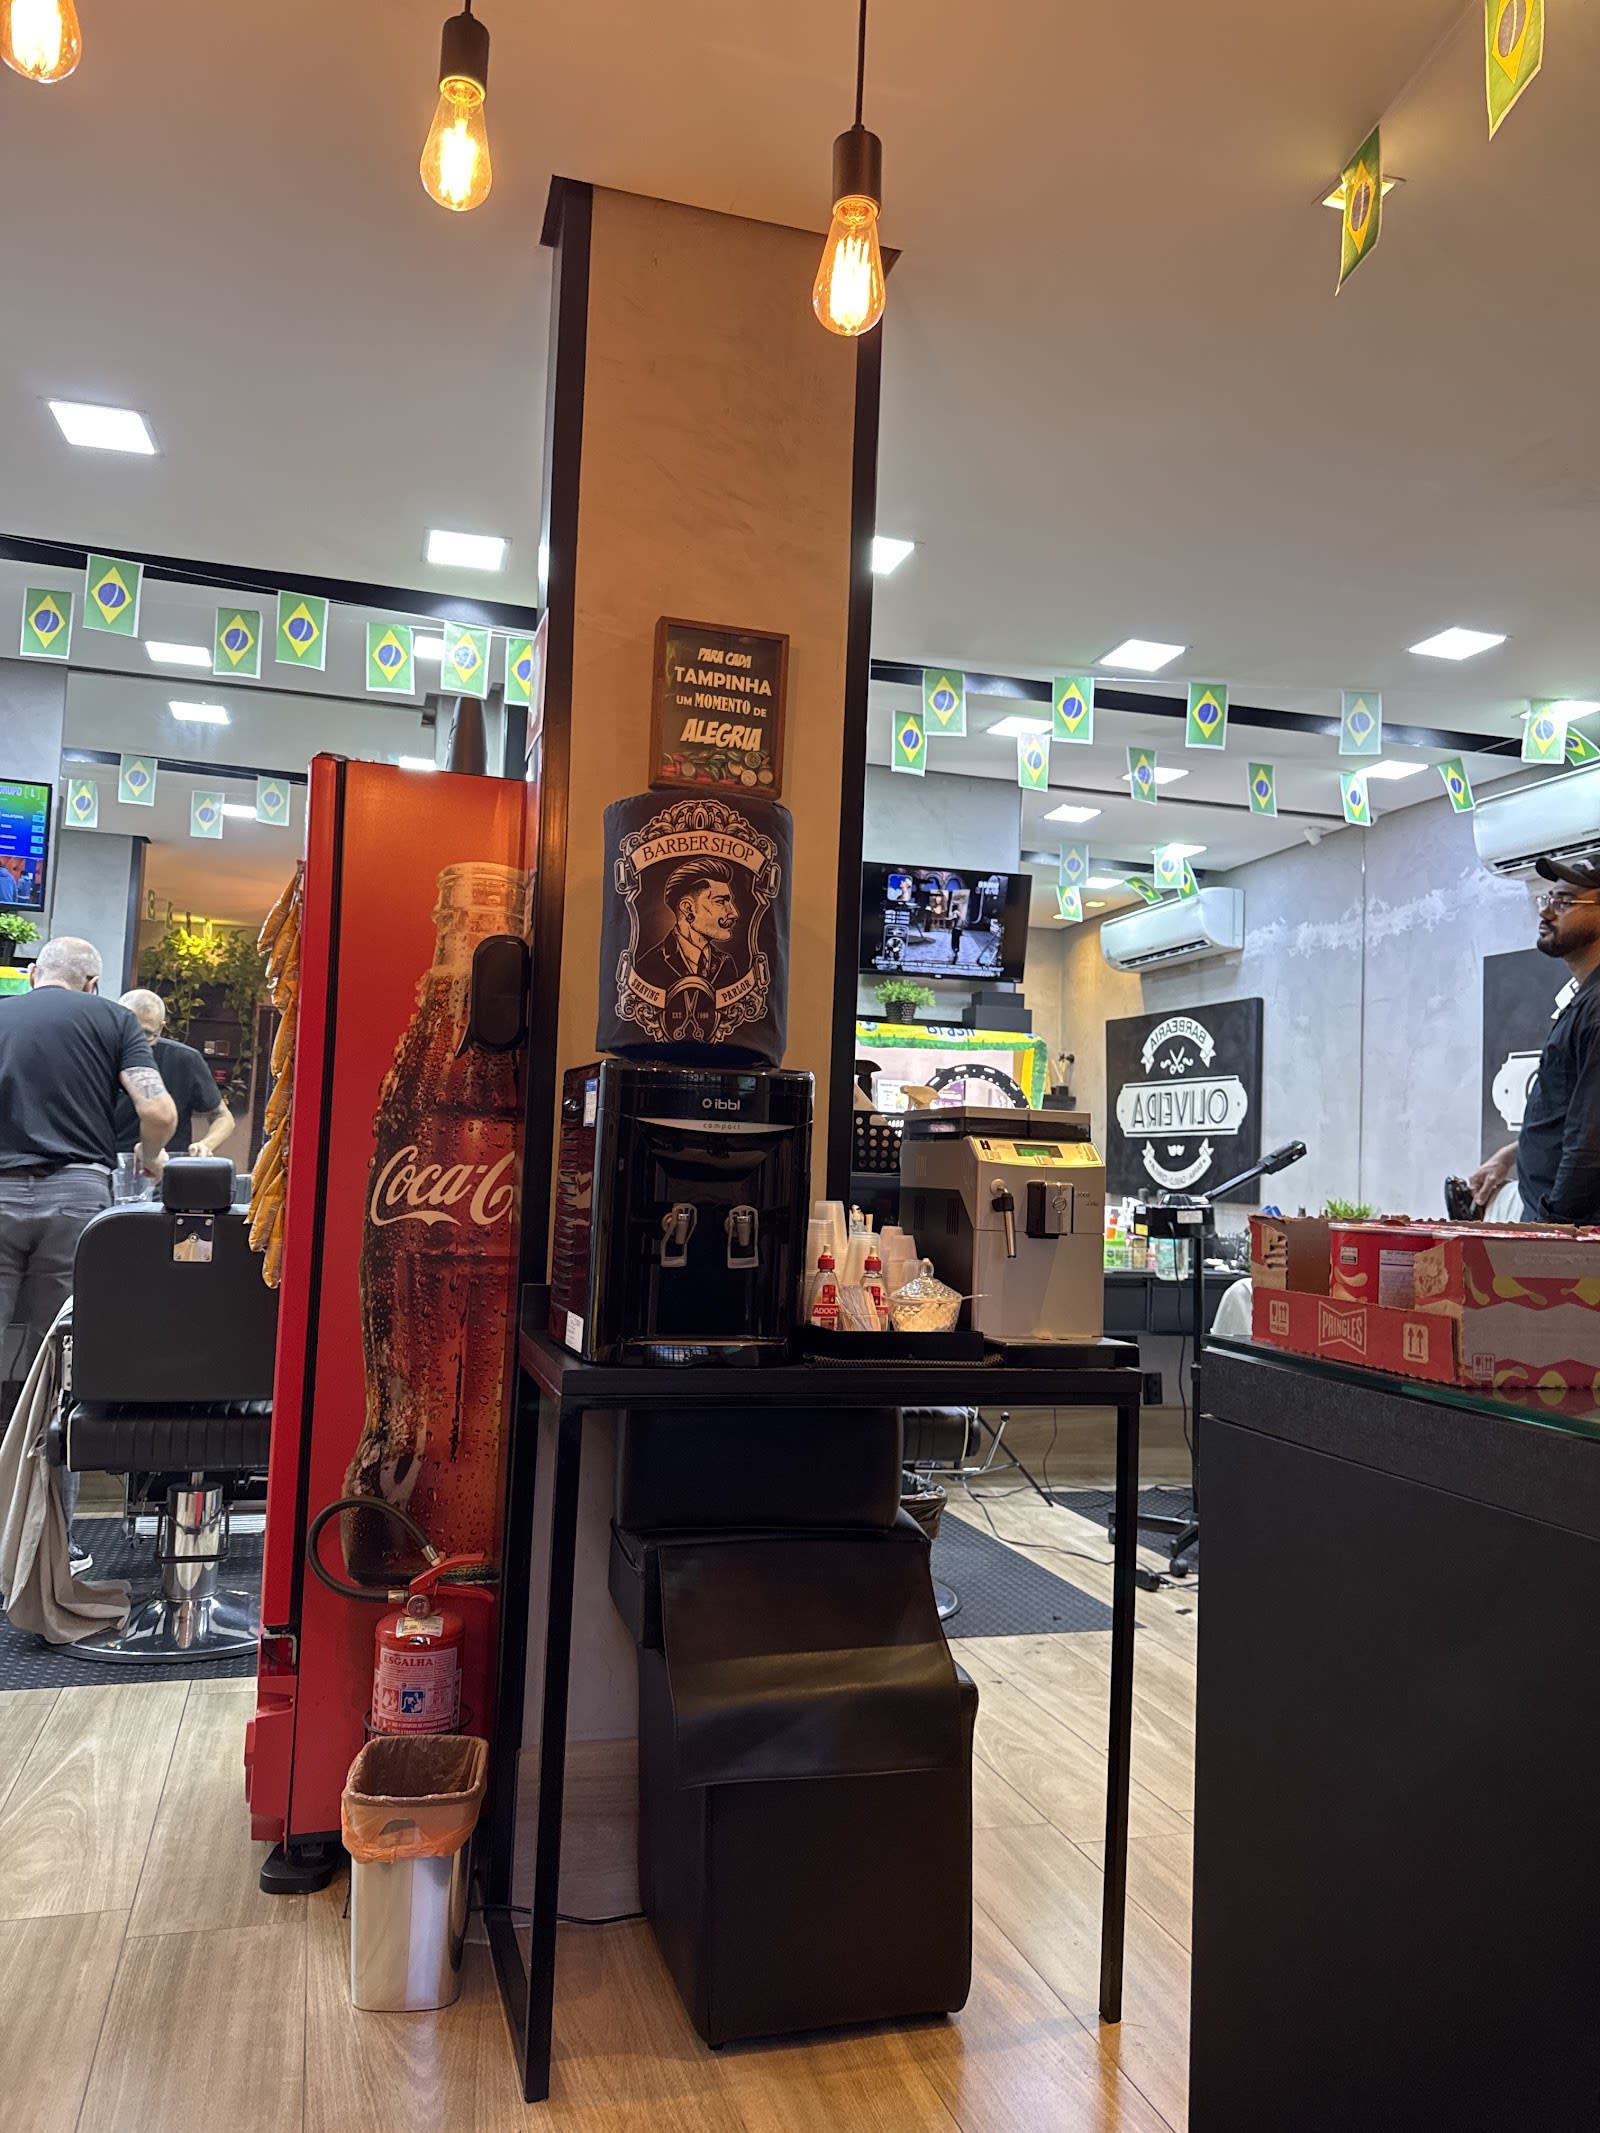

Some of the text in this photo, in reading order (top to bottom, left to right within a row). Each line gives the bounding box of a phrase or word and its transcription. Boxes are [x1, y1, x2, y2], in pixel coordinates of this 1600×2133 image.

[697, 648, 724, 665] PARA
[674, 666, 772, 696] TAMPINHA
[676, 692, 767, 717] UM MOMENTO DE
[680, 718, 763, 752] ALEGRIA
[631, 978, 660, 1002] SHAVING
[721, 979, 752, 1002] PARLOR
[370, 1145, 515, 1227] Coca-C
[813, 1306, 839, 1316] ADOCY
[1321, 1311, 1364, 1346] PRINGLES
